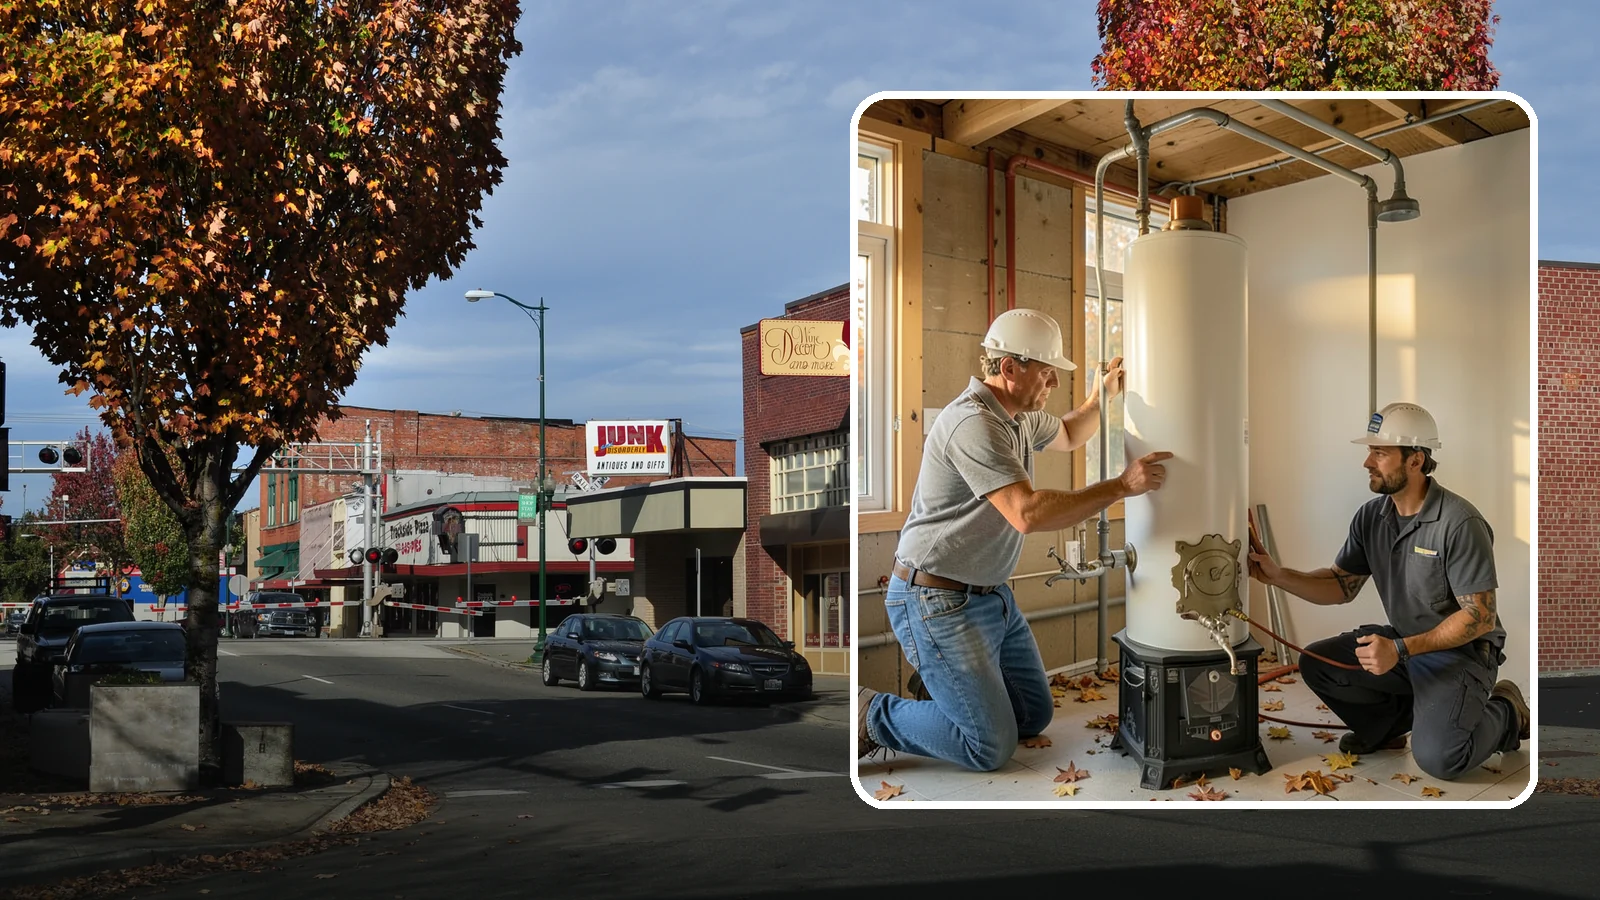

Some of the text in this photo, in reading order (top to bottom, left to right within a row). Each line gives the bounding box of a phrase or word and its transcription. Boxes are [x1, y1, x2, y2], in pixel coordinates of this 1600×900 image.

[595, 425, 666, 457] JUNK
[607, 446, 646, 455] DISORDERLY
[597, 460, 665, 471] ANTIQUES AND GIFTS
[390, 520, 429, 540] Trackside Pizza
